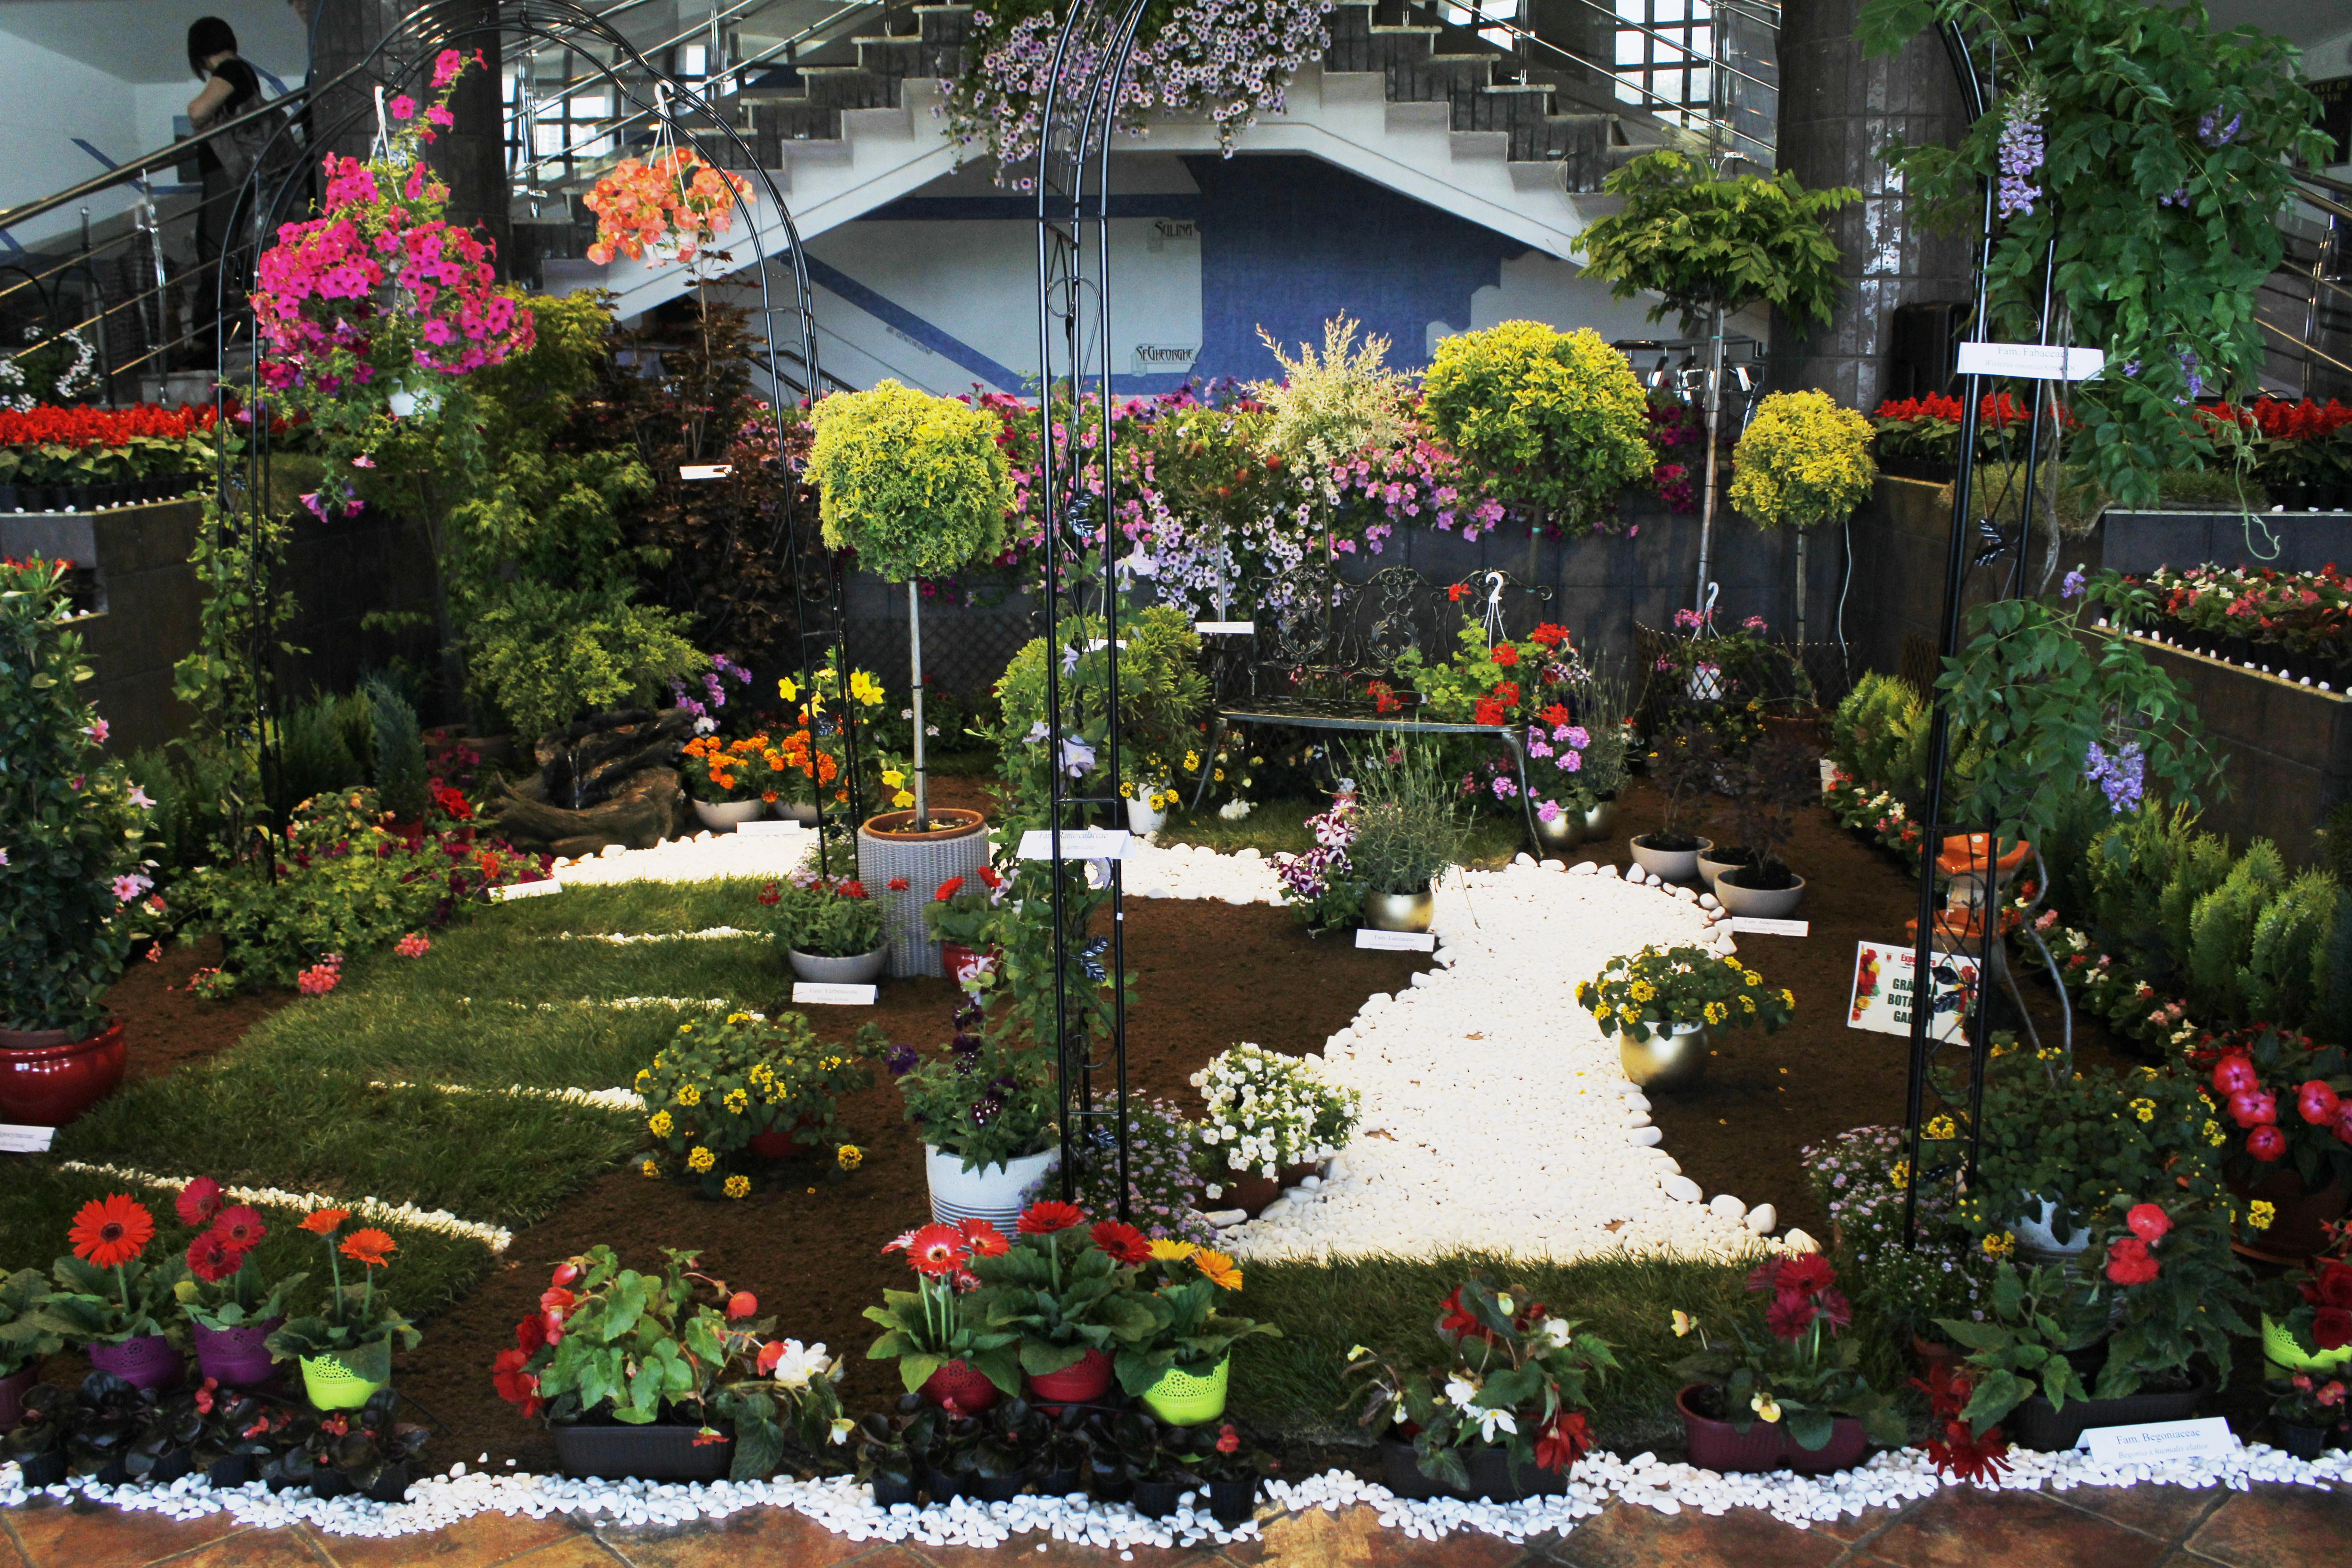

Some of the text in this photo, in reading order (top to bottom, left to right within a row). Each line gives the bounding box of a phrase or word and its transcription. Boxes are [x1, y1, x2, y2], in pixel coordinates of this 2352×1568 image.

[1155, 221, 1192, 237] SULINA
[1998, 346, 2020, 356] Fam.
[1985, 360, 2014, 368] Wisteria
[2116, 1428, 2201, 1445] Fam. Begoniaceae
